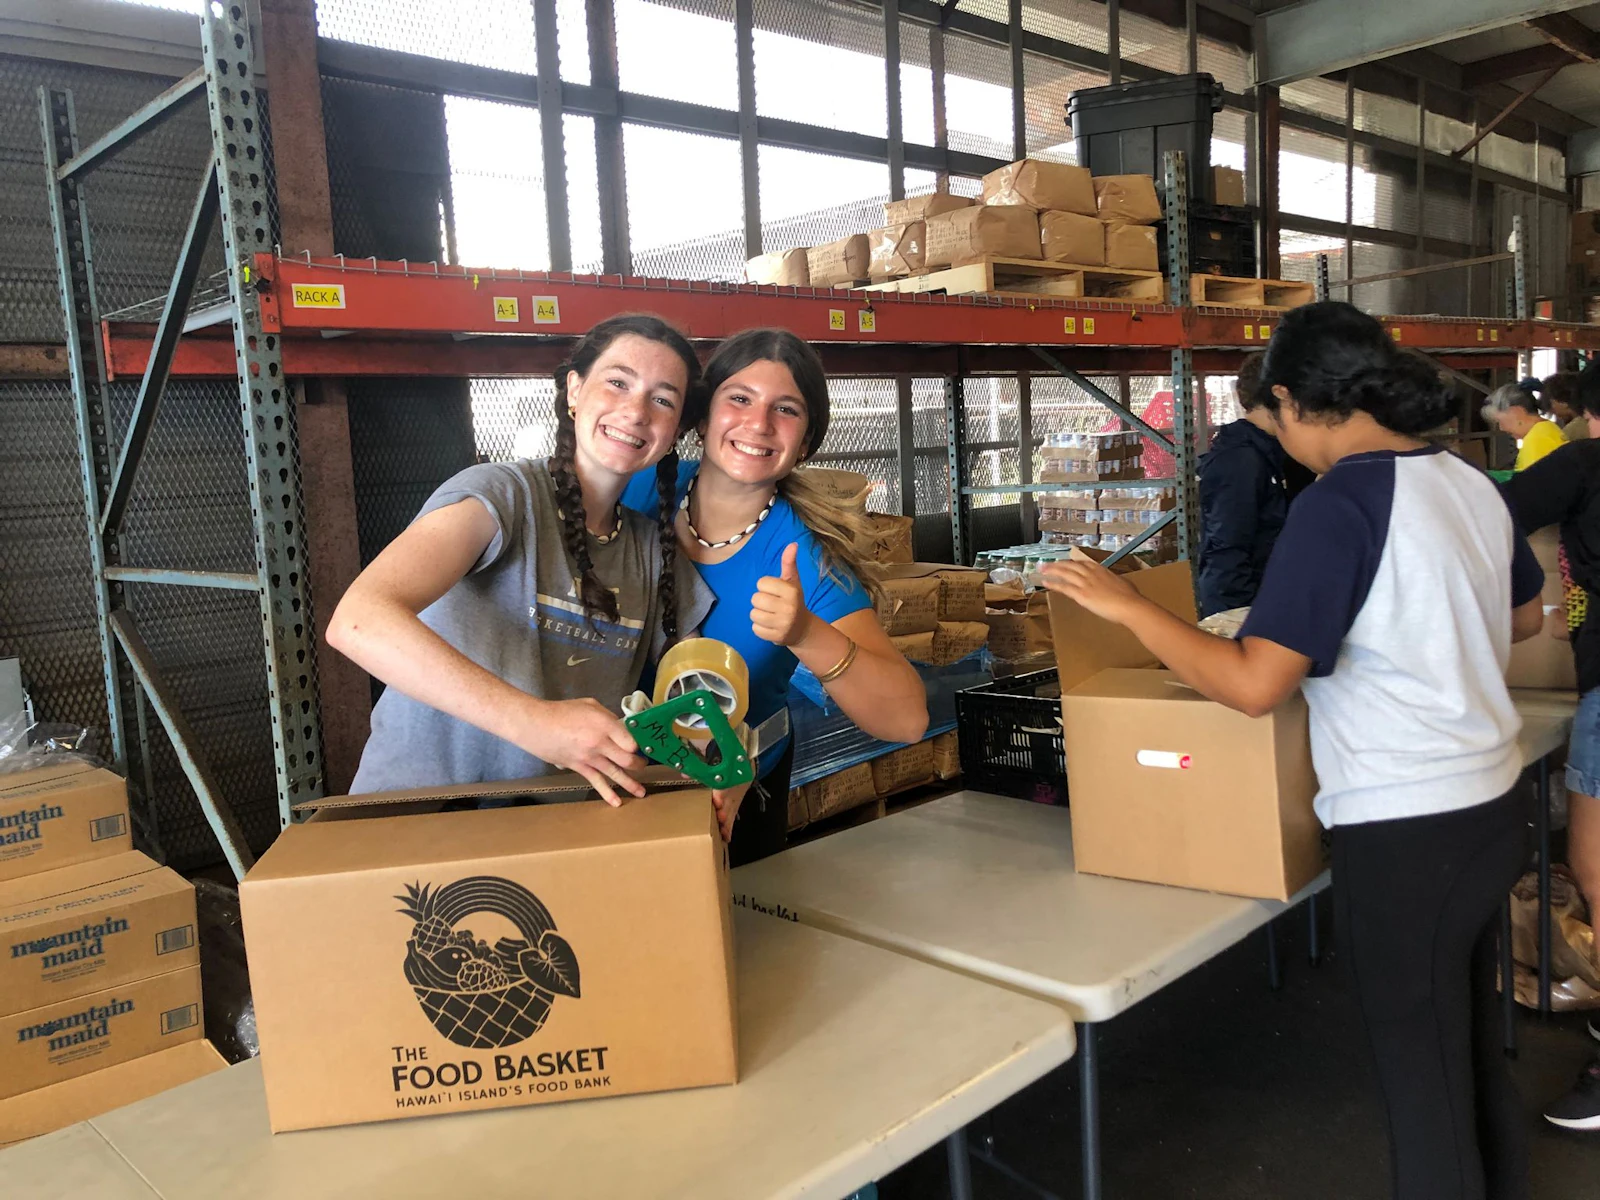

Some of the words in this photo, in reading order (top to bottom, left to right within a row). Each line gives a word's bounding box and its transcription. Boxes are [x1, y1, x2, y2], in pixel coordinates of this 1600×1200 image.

[295, 290, 329, 303] RACK
[332, 292, 341, 303] A
[497, 304, 517, 315] A-1
[537, 305, 555, 316] A-4
[831, 315, 844, 325] A-2
[861, 317, 874, 327] A-5
[41, 938, 105, 969] maid
[48, 1019, 111, 1052] maid
[392, 1046, 428, 1062] THE
[392, 1060, 482, 1092] FOOD
[495, 1047, 608, 1081] BASKET
[459, 1085, 522, 1101] ISLAND'S
[529, 1081, 568, 1094] FOOD
[575, 1076, 611, 1090] BANK
